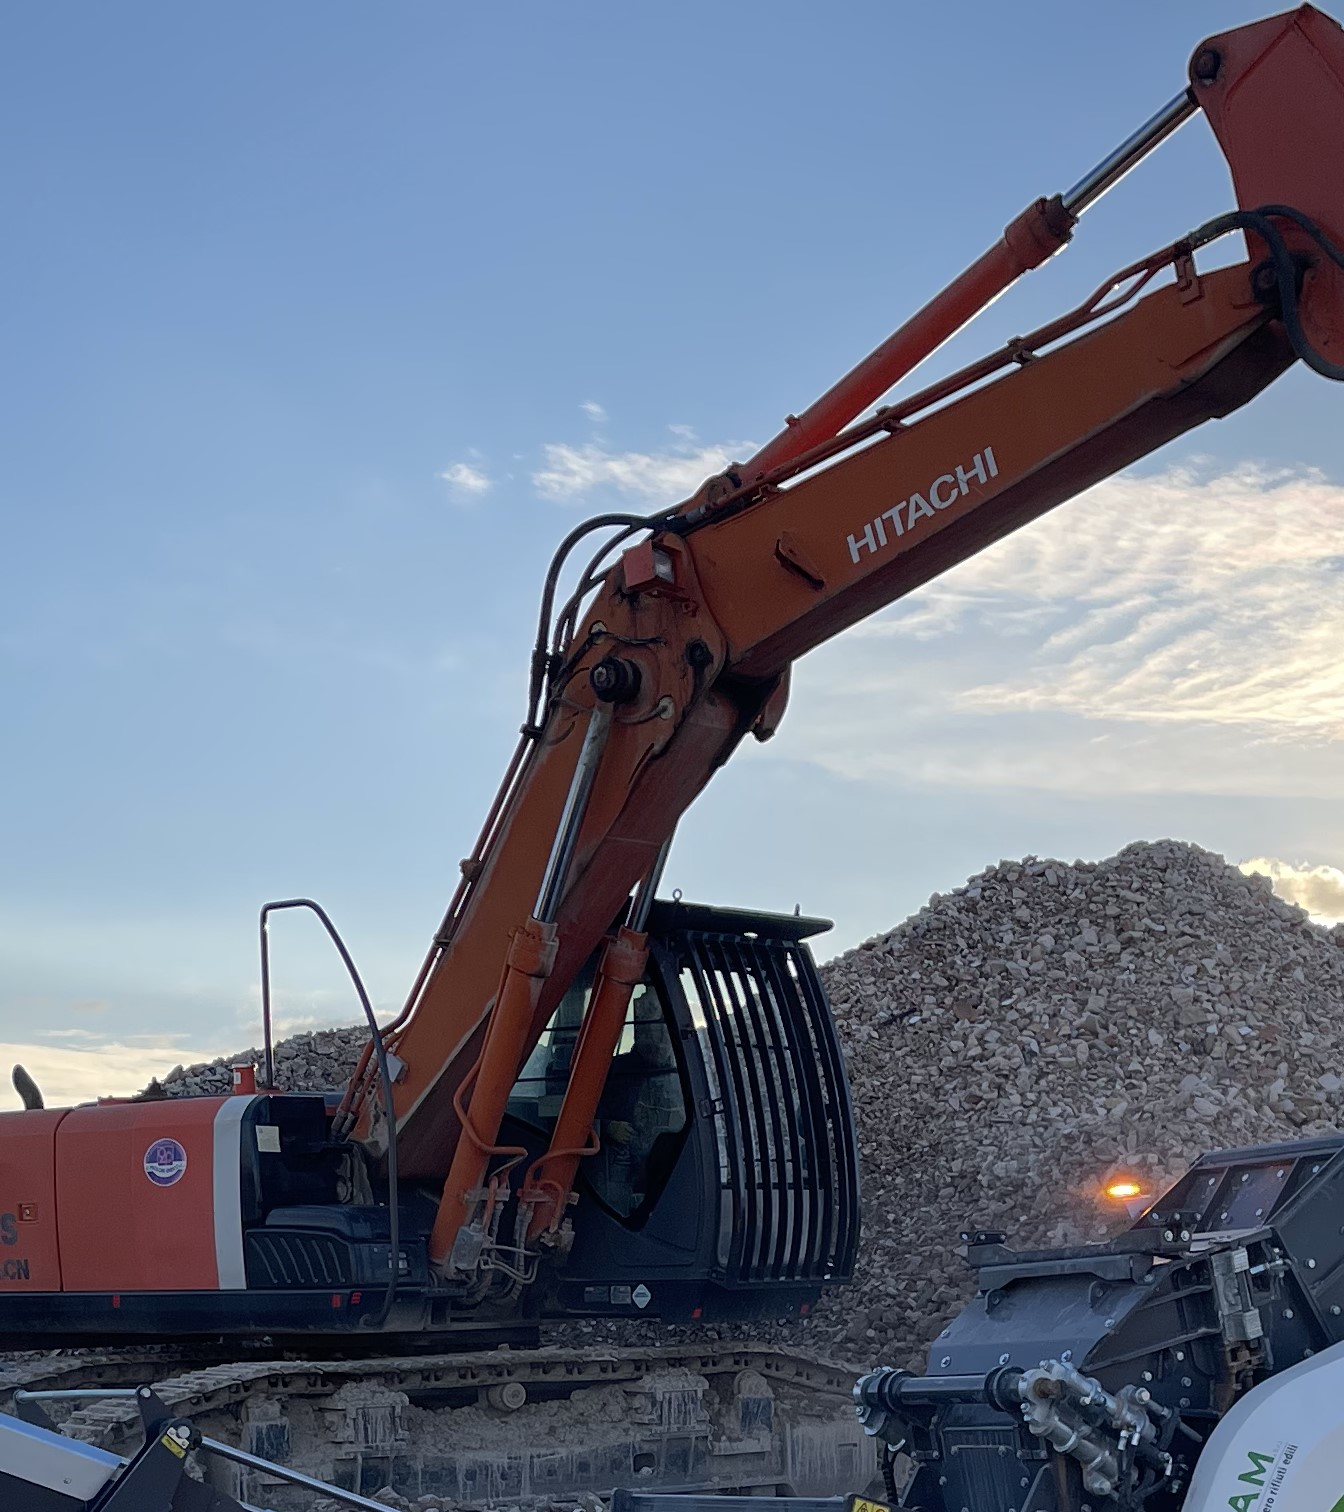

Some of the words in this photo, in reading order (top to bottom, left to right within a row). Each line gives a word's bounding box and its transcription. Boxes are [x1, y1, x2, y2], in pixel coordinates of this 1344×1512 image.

[846, 446, 999, 564] HITACHI
[1270, 1467, 1288, 1496] rifiuti
[1282, 1444, 1299, 1465] edili
